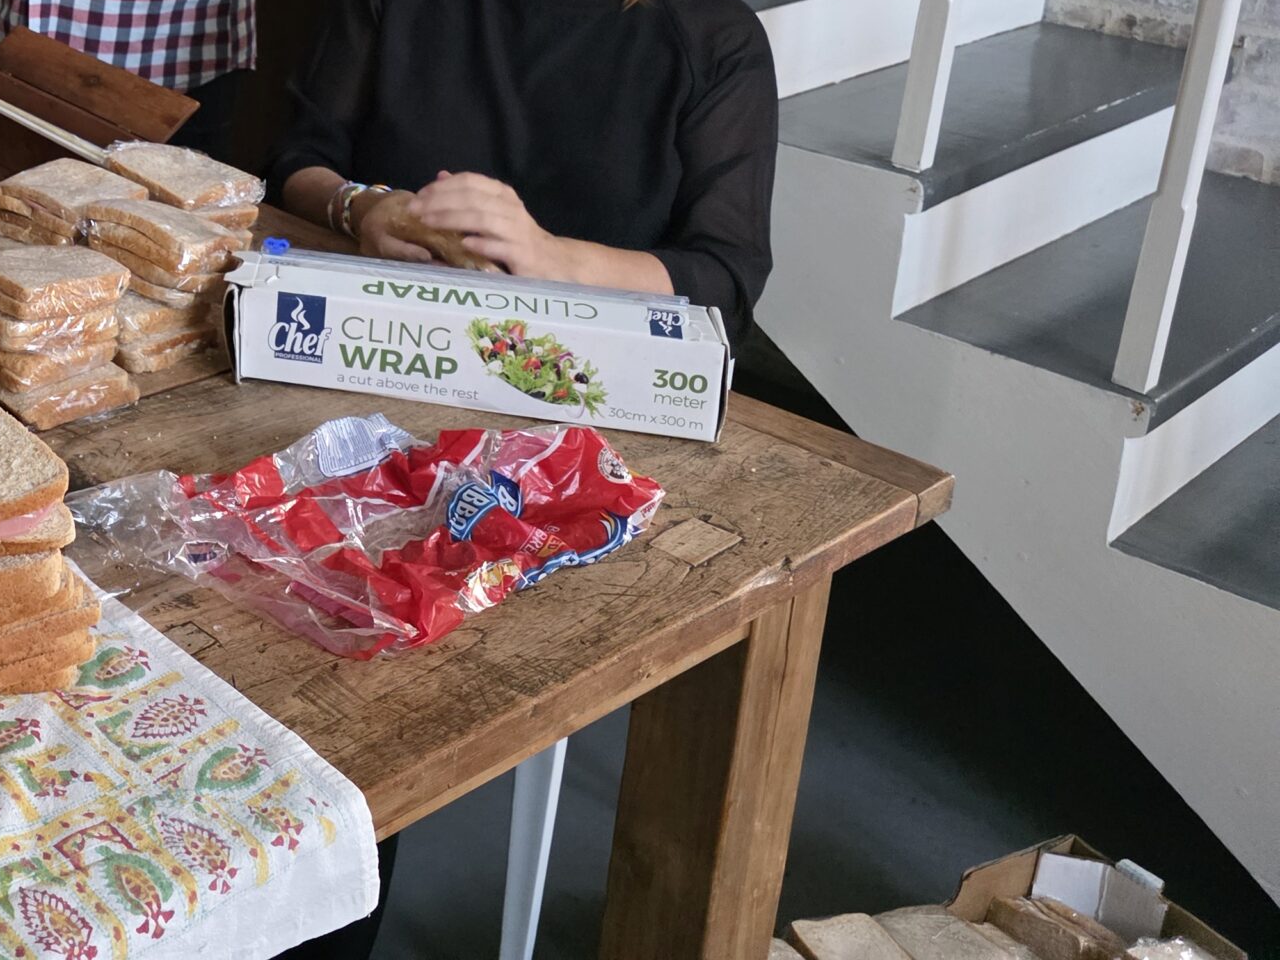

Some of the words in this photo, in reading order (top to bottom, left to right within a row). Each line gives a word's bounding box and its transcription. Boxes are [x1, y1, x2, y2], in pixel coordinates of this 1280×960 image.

[268, 321, 332, 356] Chef
[341, 316, 452, 351] CLING
[275, 351, 323, 363] PROFESSIONAL
[339, 343, 459, 380] WRAP
[336, 373, 345, 383] a
[348, 374, 372, 386] cut
[376, 377, 420, 392] above
[423, 383, 448, 396] the
[452, 388, 479, 401] rest
[652, 368, 708, 394] 300
[653, 392, 707, 410] meter
[608, 407, 647, 423] 30cm
[649, 415, 658, 424] x
[660, 414, 686, 428] 300
[688, 420, 704, 431] m
